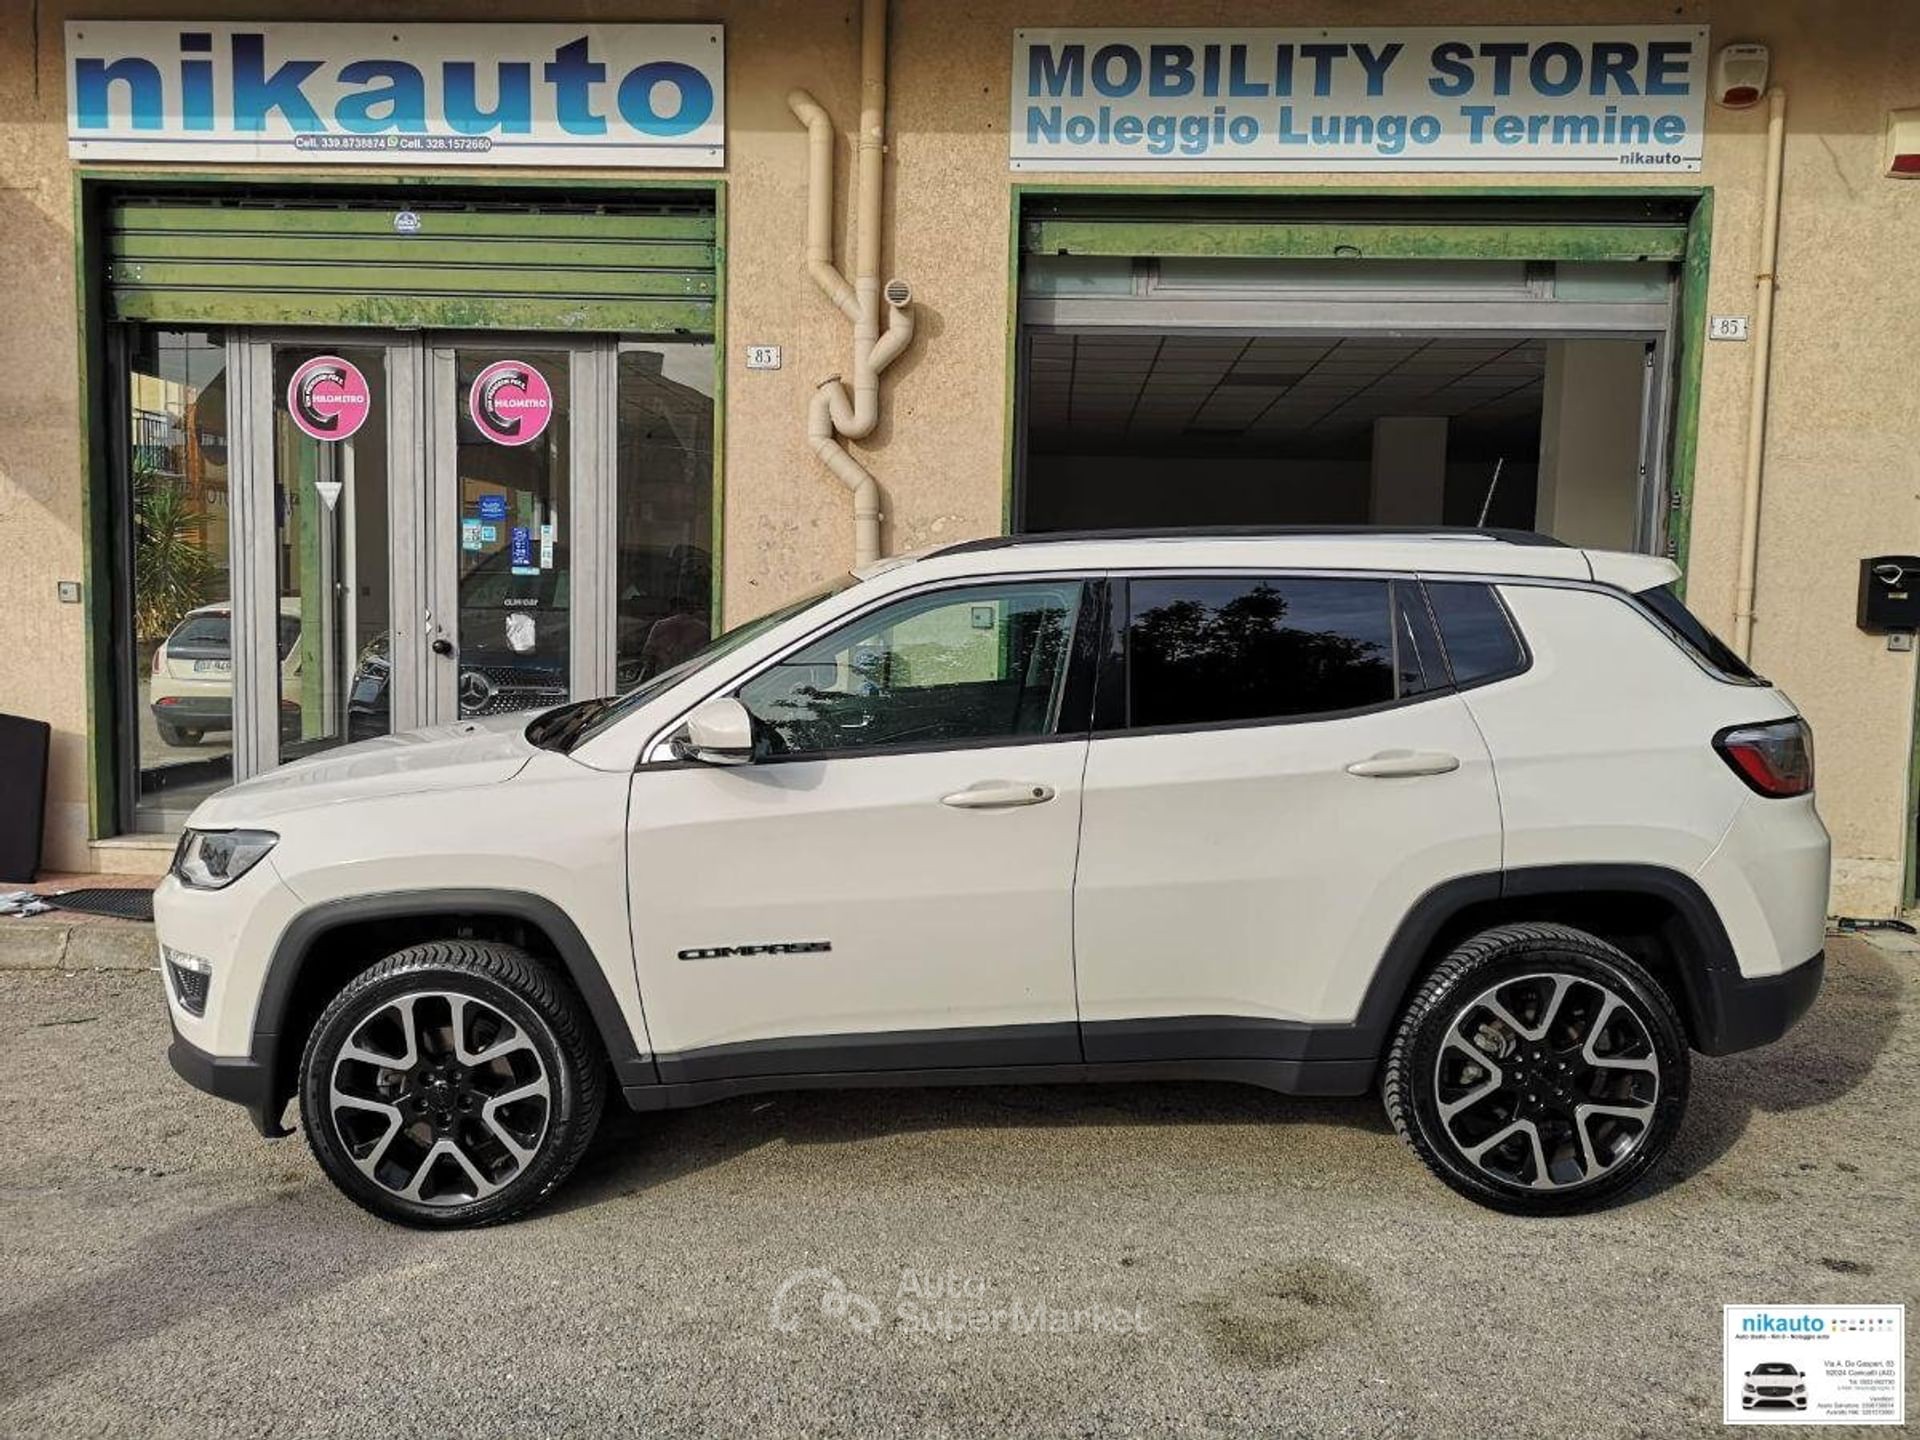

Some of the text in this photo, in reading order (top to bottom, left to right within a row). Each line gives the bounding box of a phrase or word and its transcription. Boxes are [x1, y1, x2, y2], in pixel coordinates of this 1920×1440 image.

[75, 32, 714, 136] nikauto
[1028, 41, 1691, 99] MOBILITY STORE
[1027, 105, 1687, 155] Noleggio Lungo Termine
[1619, 151, 1682, 165] nikauto
[1720, 320, 1738, 335] 85
[678, 941, 832, 961] COMPASS
